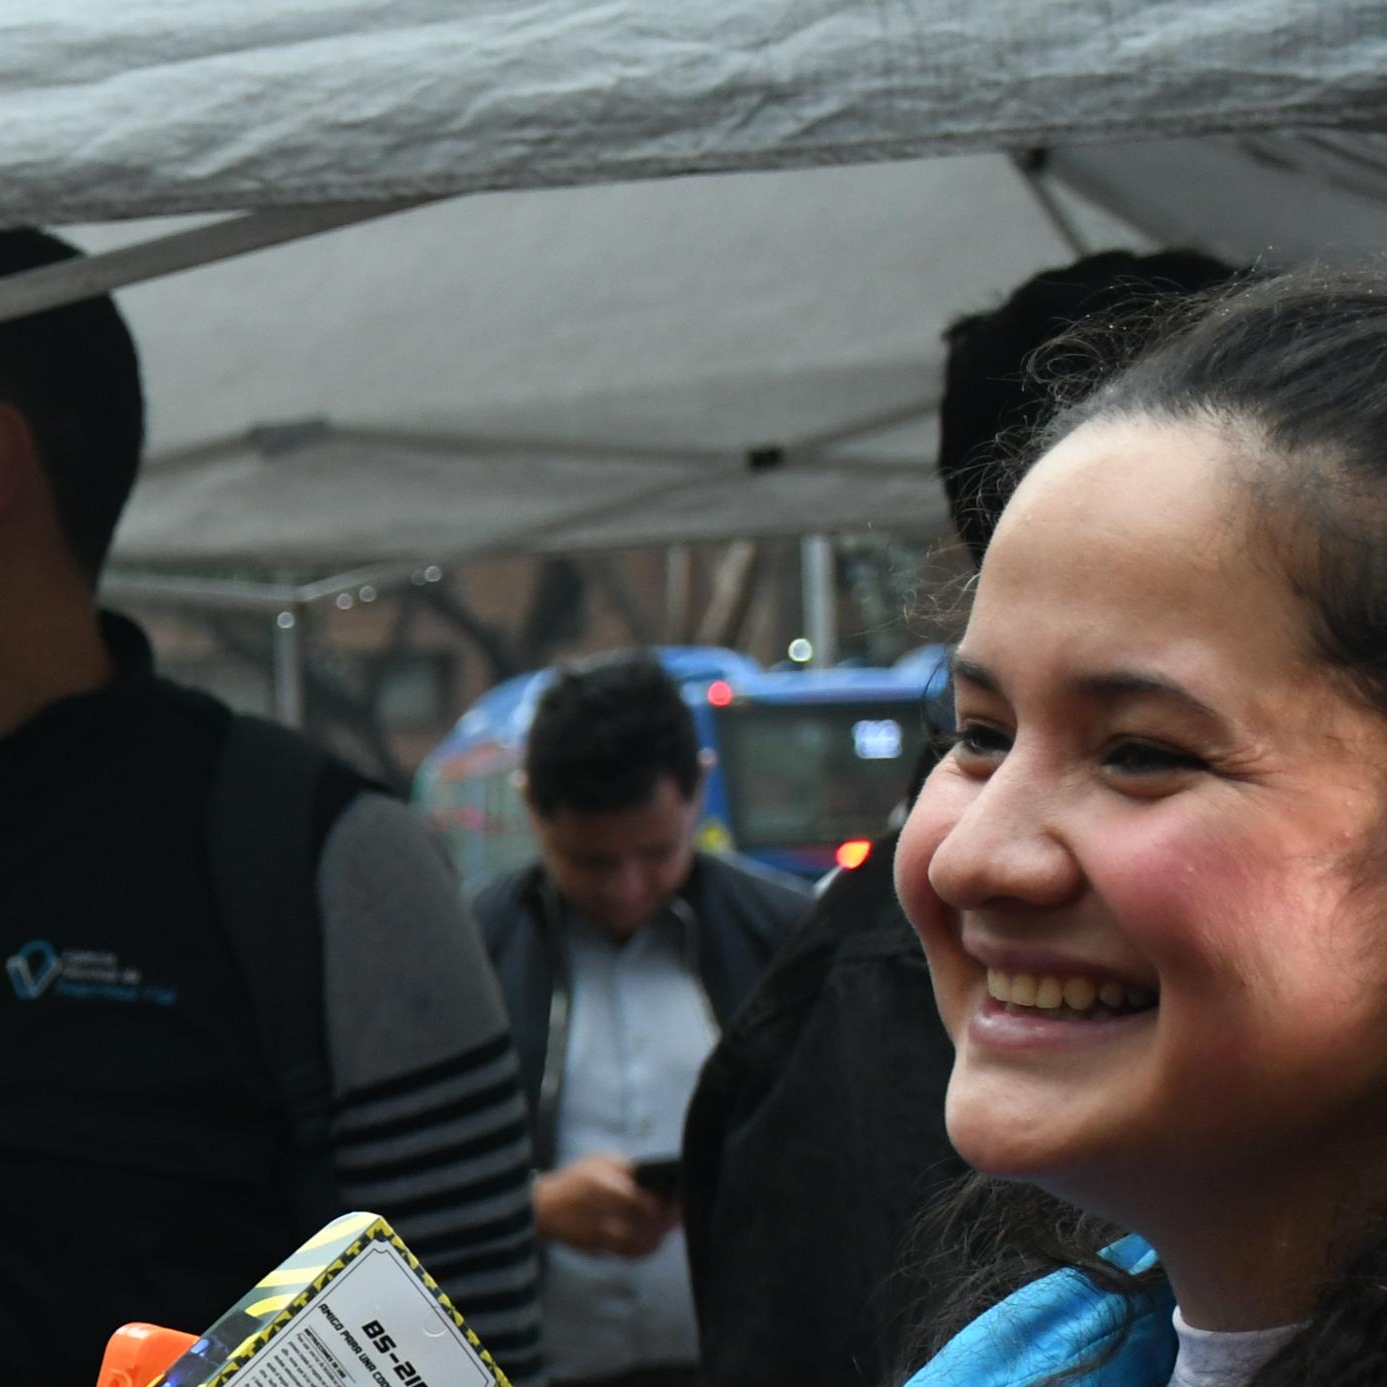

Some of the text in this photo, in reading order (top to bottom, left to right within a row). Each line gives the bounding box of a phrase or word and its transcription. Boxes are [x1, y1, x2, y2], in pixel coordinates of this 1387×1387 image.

[318, 1303, 344, 1331] AMIGO
[340, 1329, 363, 1355] PARA
[358, 1353, 377, 1372] UNA
